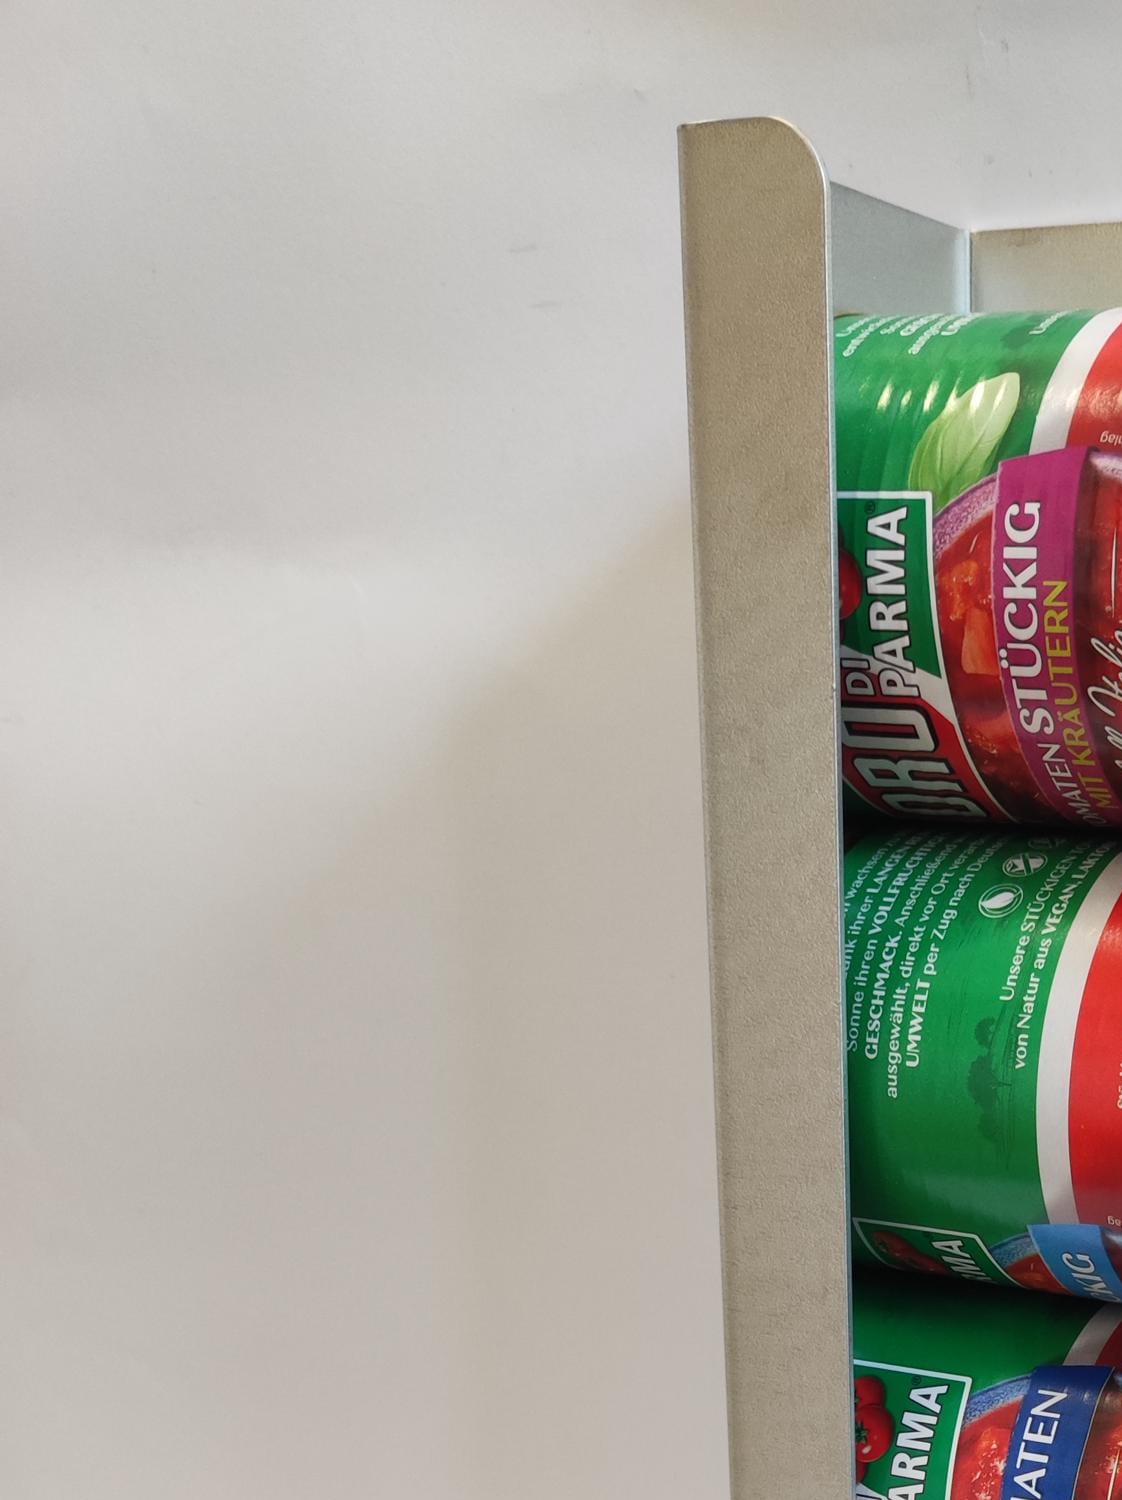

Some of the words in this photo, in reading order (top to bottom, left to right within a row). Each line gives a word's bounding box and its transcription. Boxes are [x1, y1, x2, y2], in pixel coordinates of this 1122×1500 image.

[865, 505, 921, 698] PARMA
[998, 501, 1056, 735] STÜCKIG
[841, 657, 877, 696] DI
[1041, 580, 1097, 766] KRÄUTERN
[1076, 773, 1119, 809] MIT
[845, 888, 875, 928] ihrer
[948, 872, 976, 906] nach
[1039, 880, 1083, 936] VEGAN,
[929, 908, 958, 940] Zug
[854, 938, 878, 986] ihren
[922, 941, 945, 976] per
[998, 934, 1031, 1002] Unsere
[1032, 938, 1052, 971] aus
[864, 930, 903, 1060] GESCHMACK.
[885, 982, 911, 1099] ausgewählt,
[899, 925, 926, 978] direkt
[918, 896, 938, 923] vor
[930, 871, 956, 896] Ort
[1016, 972, 1042, 1029] Natur
[845, 991, 865, 1053] Sonne
[905, 977, 931, 1068] UMWELT
[1014, 1033, 1029, 1070] von
[1061, 1252, 1122, 1303] CKIG
